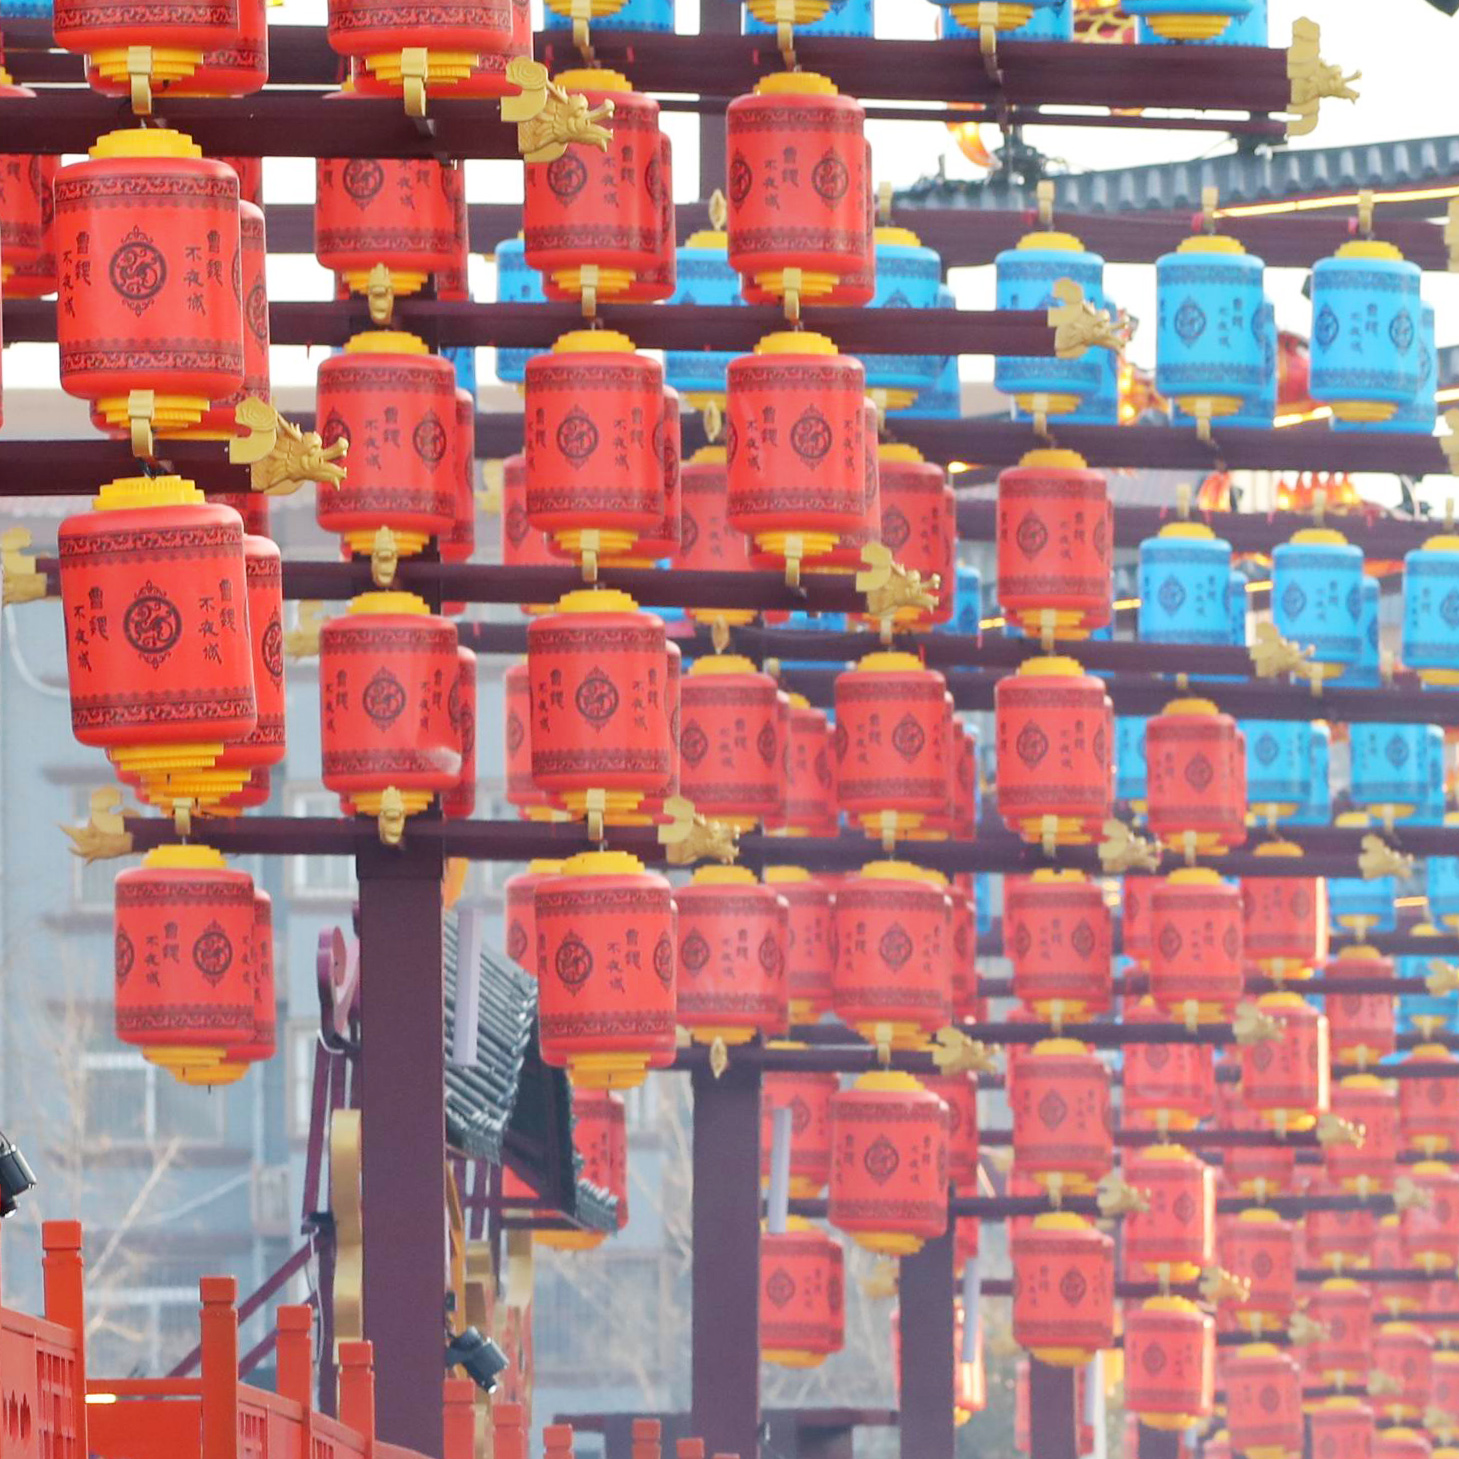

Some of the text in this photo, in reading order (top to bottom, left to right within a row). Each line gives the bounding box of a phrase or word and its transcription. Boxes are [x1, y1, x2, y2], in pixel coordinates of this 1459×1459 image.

[75, 230, 90, 286] 曹魏
[184, 246, 205, 316] 不夜城
[207, 229, 222, 286] 曹魏
[88, 586, 108, 640] 曹魏
[199, 597, 225, 664] 不夜城
[219, 579, 235, 633] 曹魏
[74, 601, 94, 671] 不夜城
